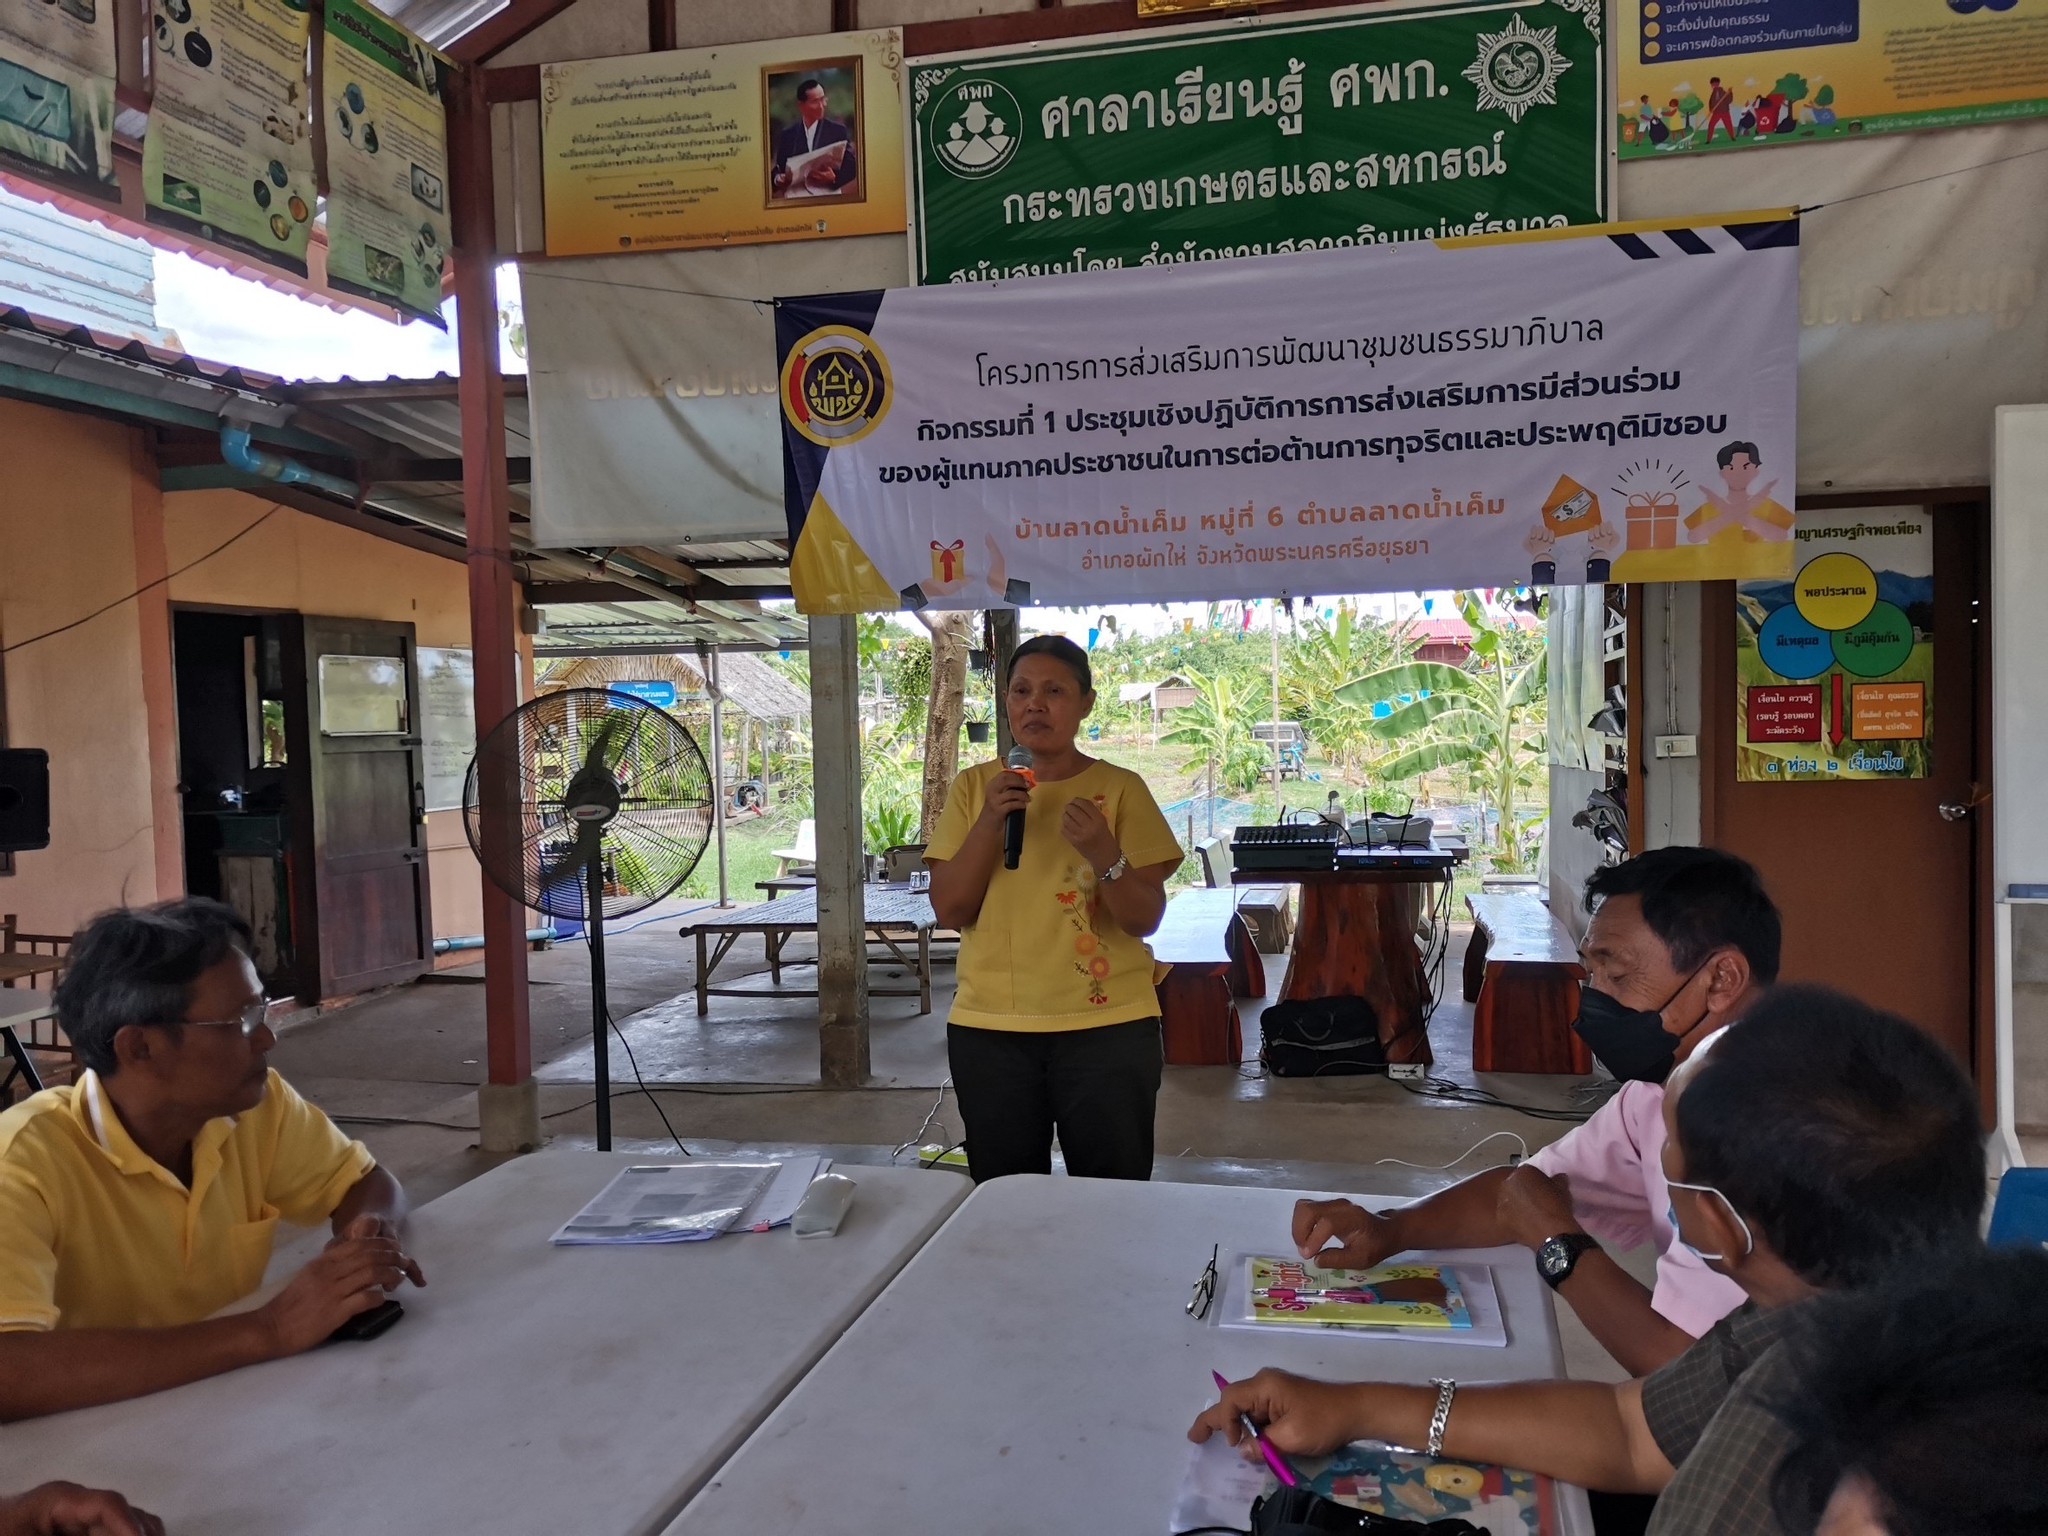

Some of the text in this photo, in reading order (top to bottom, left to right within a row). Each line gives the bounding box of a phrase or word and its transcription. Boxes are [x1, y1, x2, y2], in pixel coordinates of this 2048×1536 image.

[957, 84, 993, 101] ศพก
[1041, 57, 1449, 139] ศาลาเรียนรู้ ศพก.
[1002, 130, 1508, 225] กระทรวงเกษตรและสหกรณ์
[975, 316, 1604, 387] โครงการการส่งเสริมการพัฒนาชุมชนธรรมาภิบาล
[917, 366, 1681, 441] กิจกรรมที่ 1 ประชุมเชิงปฏิบัติการการส่งเสริมการมีส่วนร่วม
[879, 413, 1728, 489] ของผู้แทนภาคประชาชนในการต่อต้านการทุจริตและประพฤติมิชอบ
[1014, 489, 1506, 540] บ้านลาดน้ำเค็ม หมู่ที่ 6 ตำบลลาดน้ำเค็ม
[1795, 521, 1922, 542] ญาเศรษฐกิจพอเพียง
[1197, 536, 1430, 566] จังหวัดพระนครศรีอยุธยา
[1804, 586, 1867, 598] พอประมาณ
[1787, 755, 1819, 773] ห่วง
[1848, 749, 1904, 772] เงื่อนไข
